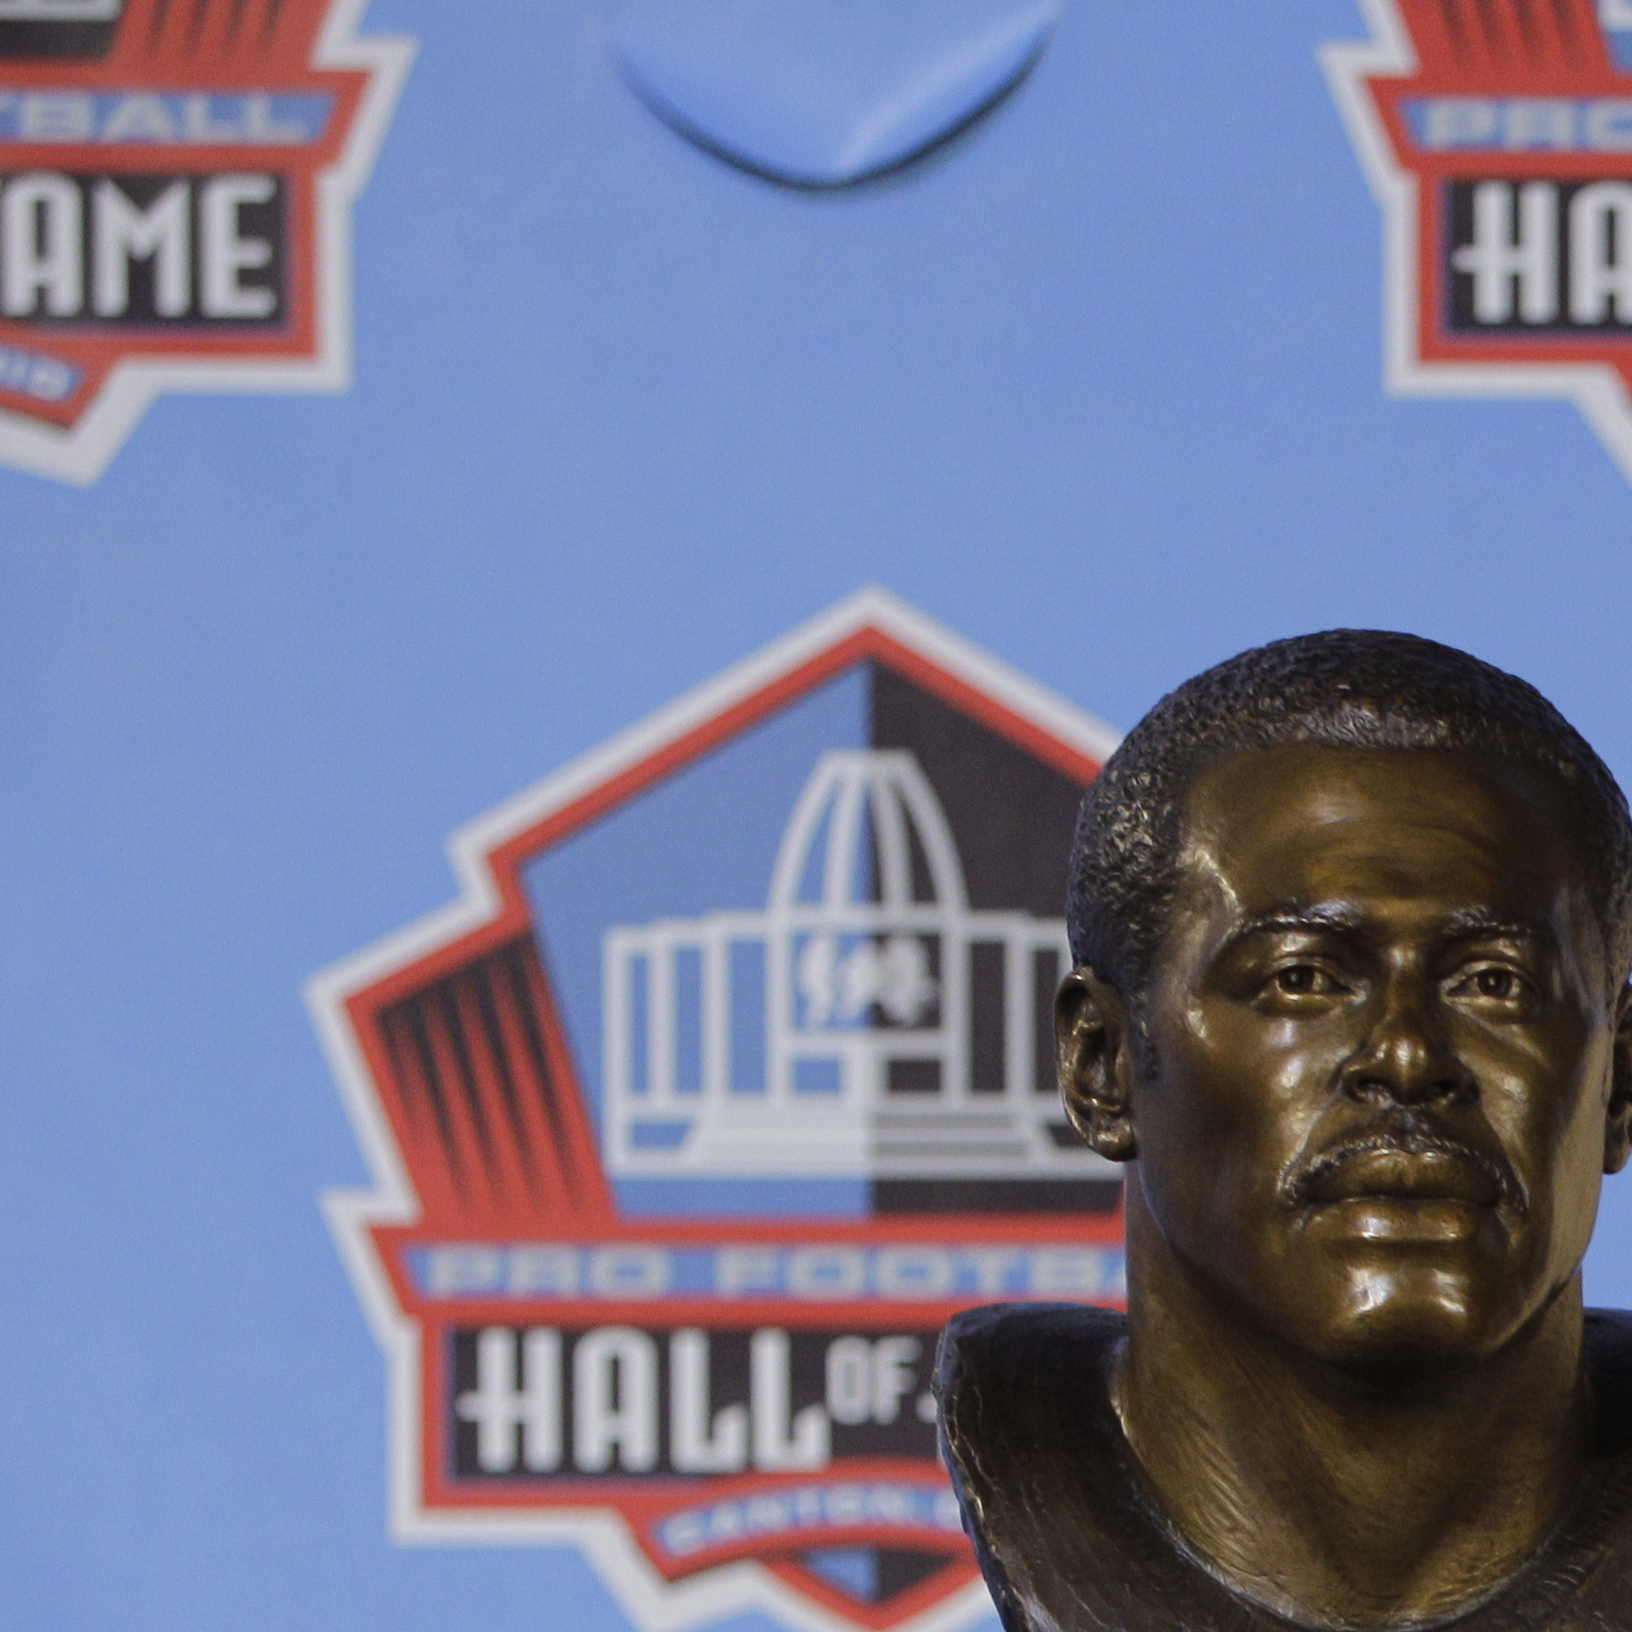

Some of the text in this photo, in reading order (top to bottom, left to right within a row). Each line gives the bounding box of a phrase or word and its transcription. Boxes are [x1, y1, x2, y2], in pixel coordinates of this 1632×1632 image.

[0, 92, 306, 145] BALL
[0, 172, 277, 318] AME
[427, 1244, 1126, 1299] PRO FOOTB
[457, 1328, 921, 1473] HALL OF
